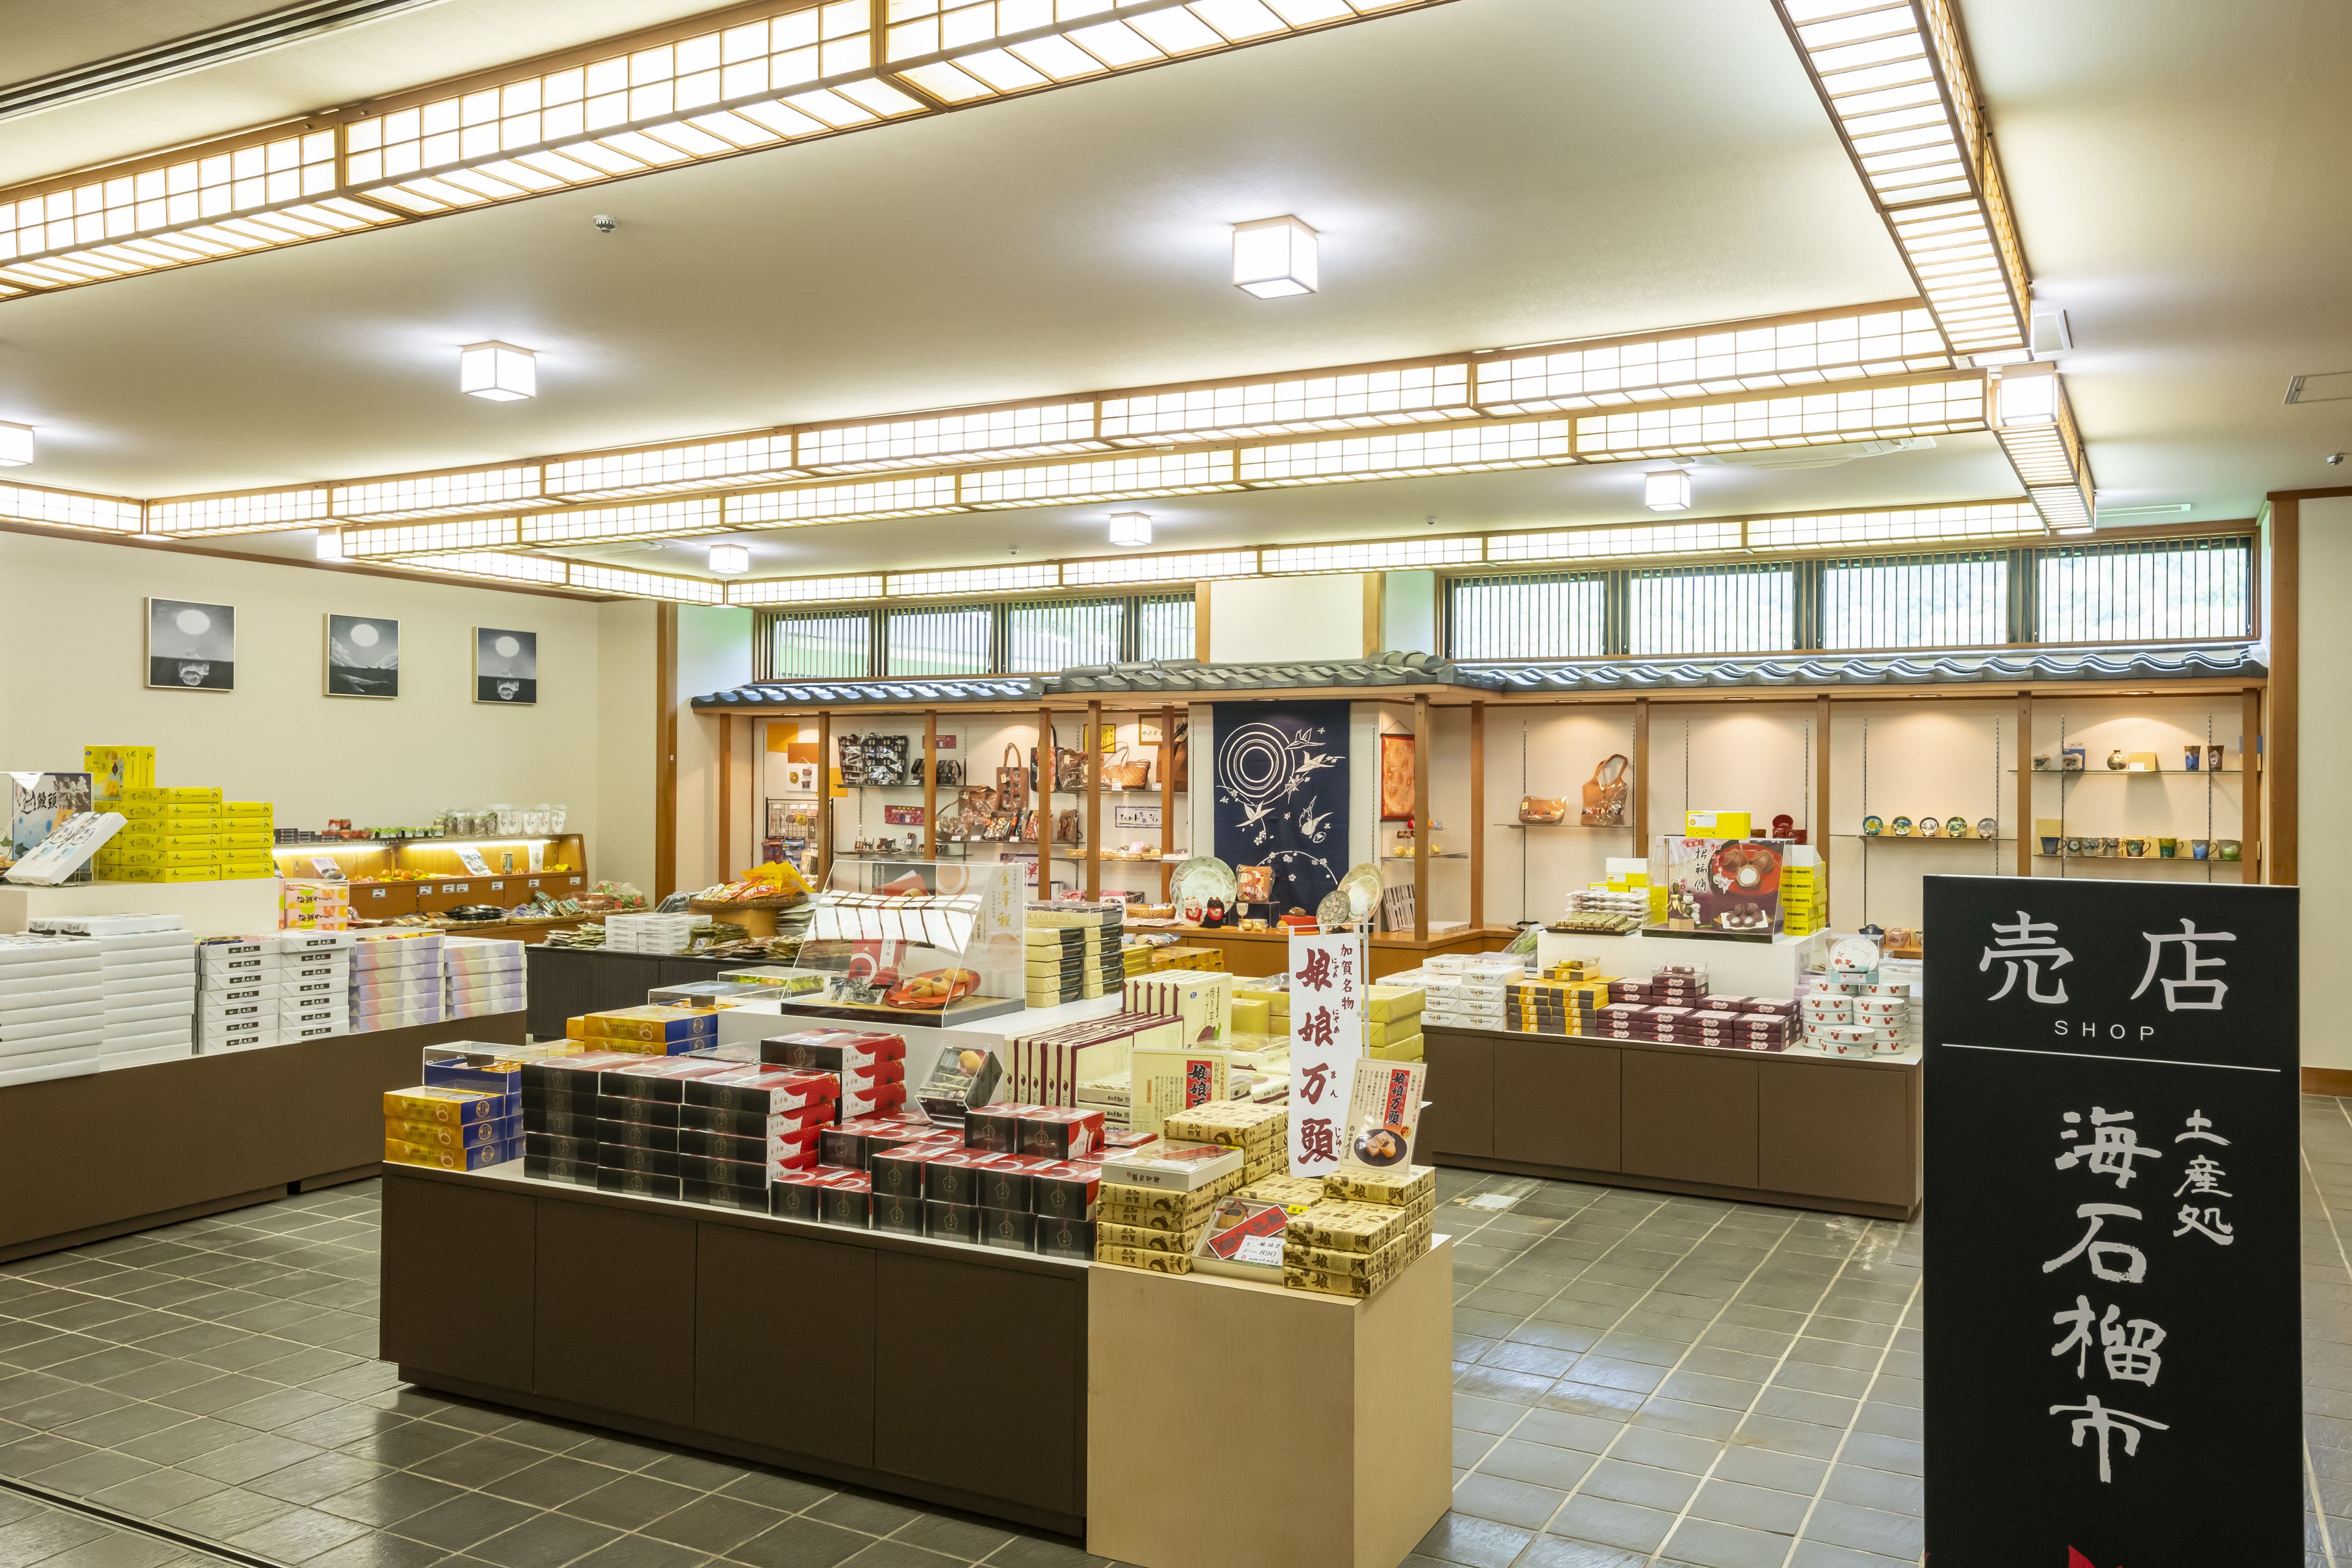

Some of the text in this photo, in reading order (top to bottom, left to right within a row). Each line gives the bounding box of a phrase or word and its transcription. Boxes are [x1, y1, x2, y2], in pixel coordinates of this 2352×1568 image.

[1027, 913, 1071, 922] KANAZAWA
[1340, 944, 1354, 1010] 加賀名物
[1980, 911, 2237, 1012] 売店
[1295, 948, 1338, 1164] 娘娘万頭
[2055, 1020, 2155, 1041] SHOP
[1389, 1072, 1405, 1125] 娘娘万頭
[2174, 1109, 2235, 1246] 土産処
[2043, 1107, 2169, 1483] 海石榴市
